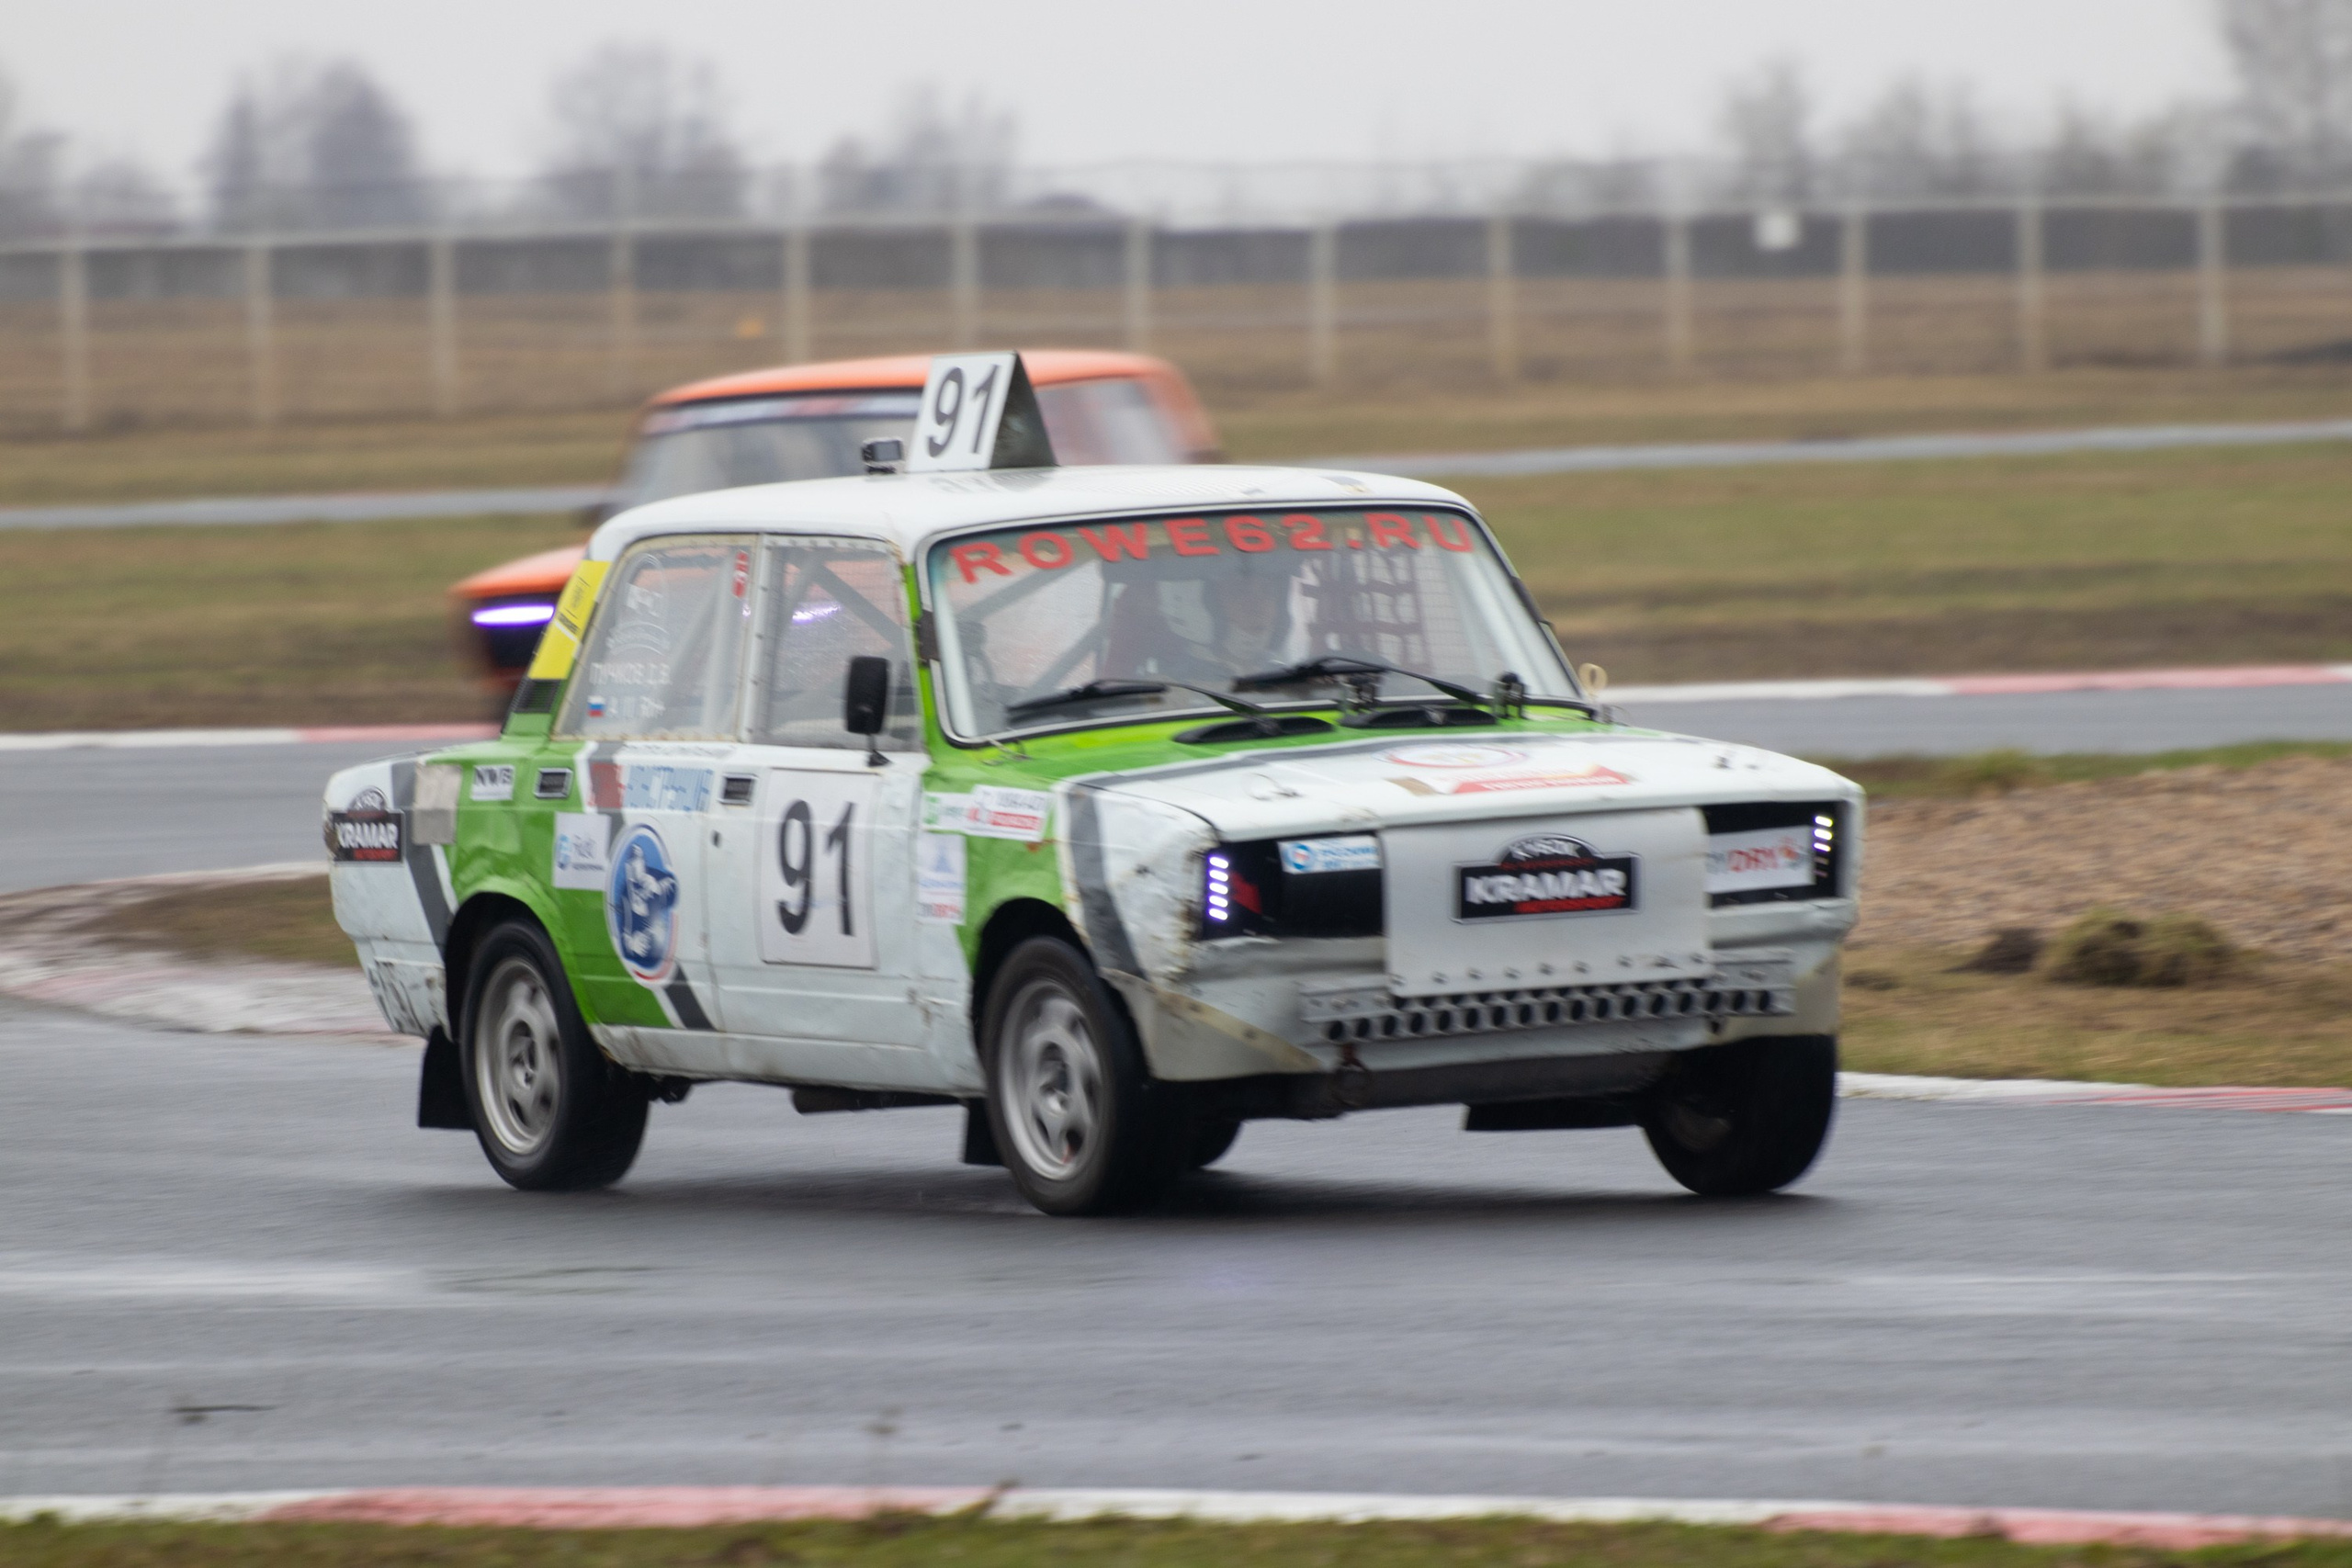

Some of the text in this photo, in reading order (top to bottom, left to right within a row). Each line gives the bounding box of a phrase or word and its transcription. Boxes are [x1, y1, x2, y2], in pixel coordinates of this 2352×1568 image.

[926, 364, 1000, 458] 91
[950, 513, 1473, 583] ROWE62.RU
[776, 798, 855, 937] 91
[1464, 868, 1627, 905] KRAMAR
